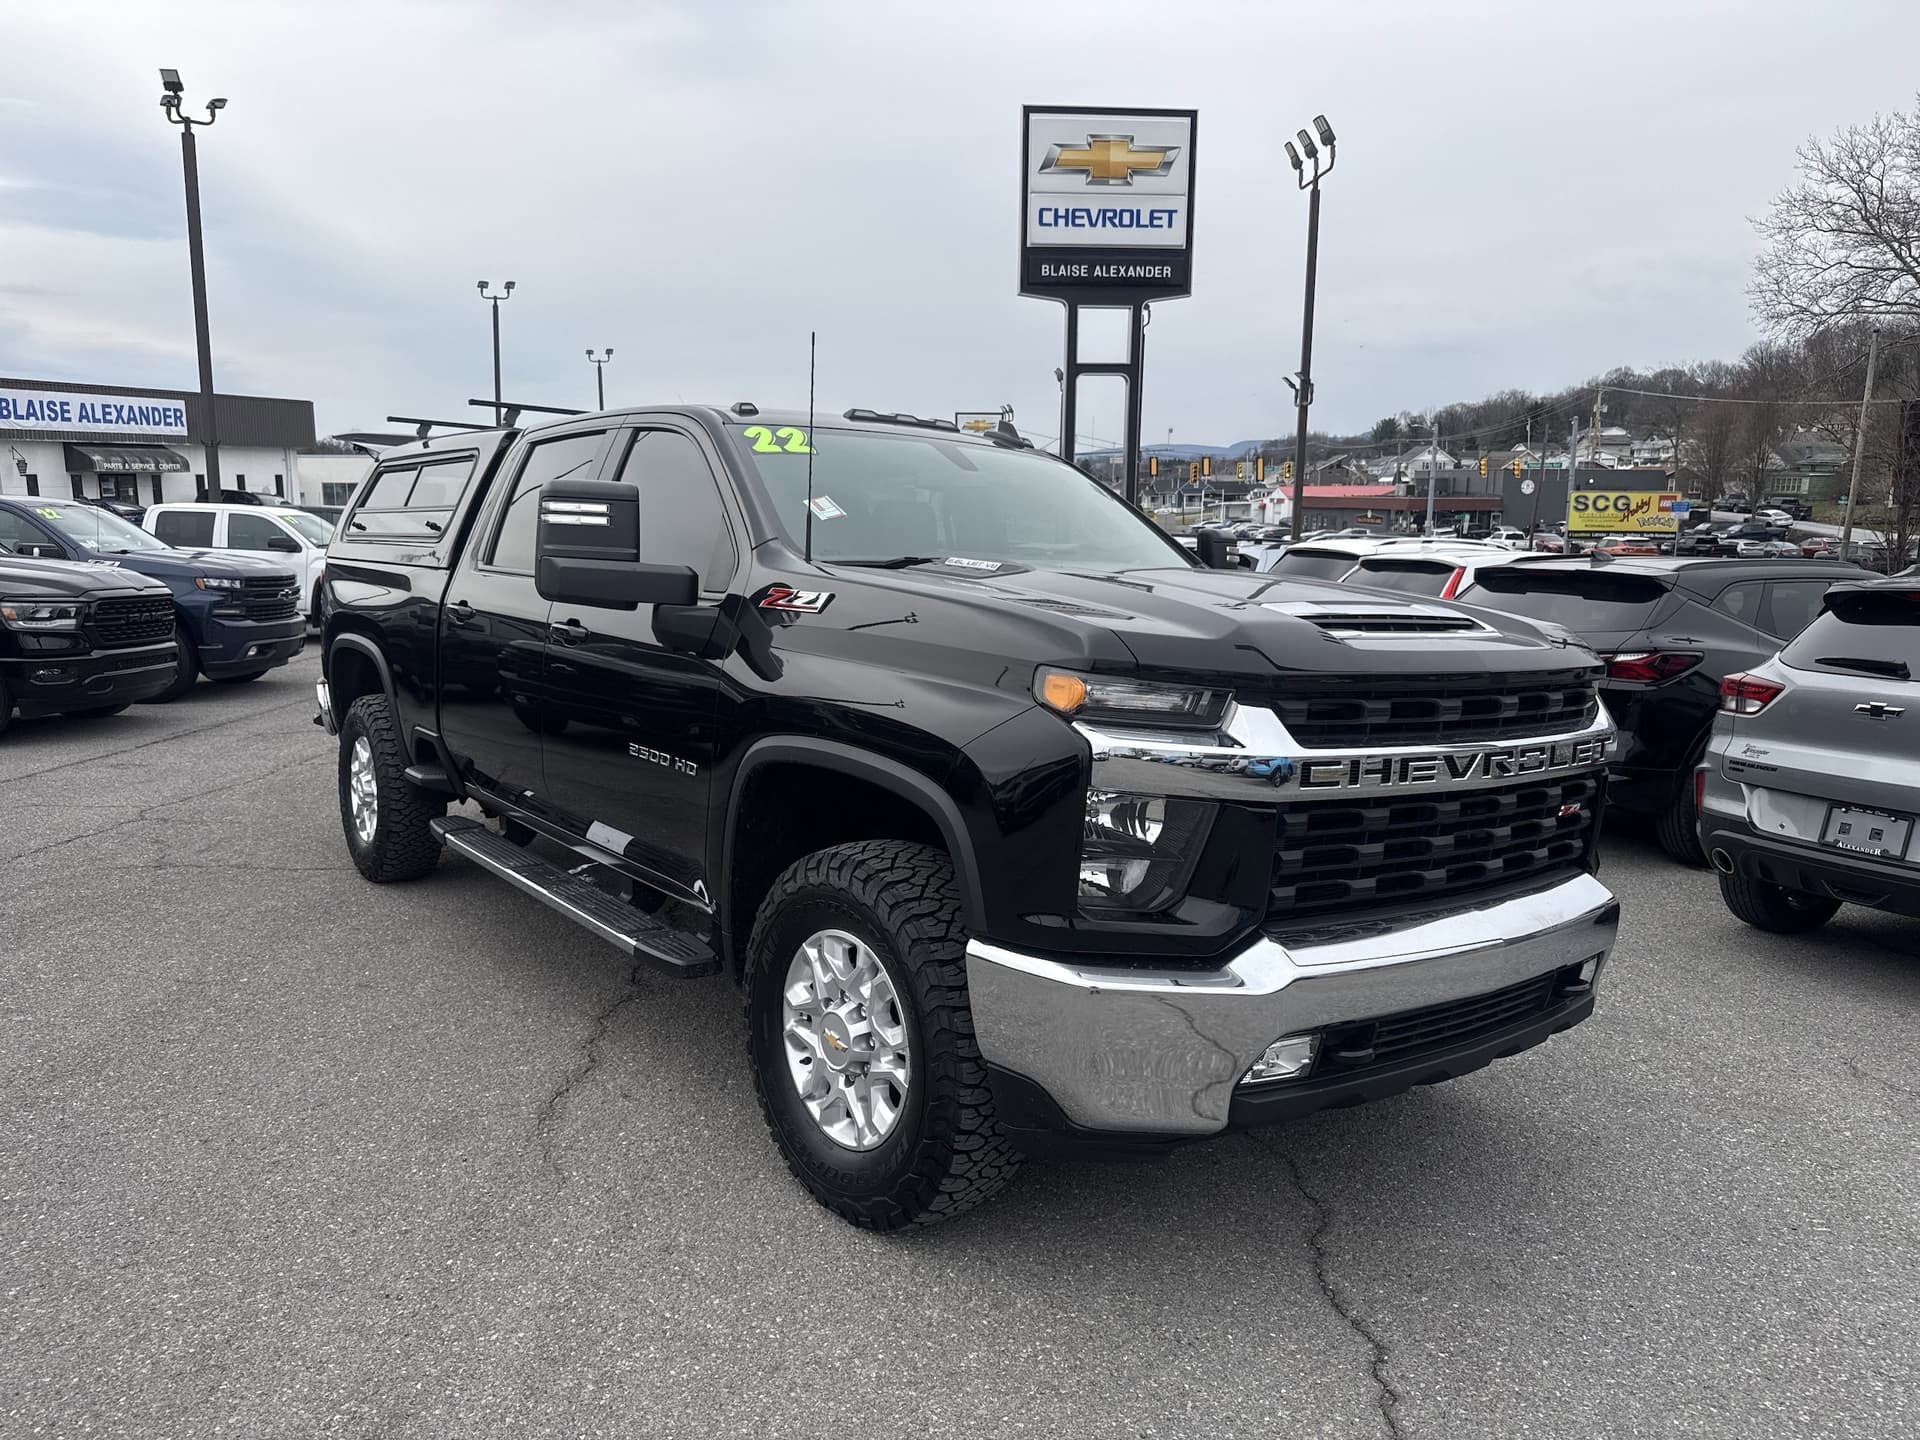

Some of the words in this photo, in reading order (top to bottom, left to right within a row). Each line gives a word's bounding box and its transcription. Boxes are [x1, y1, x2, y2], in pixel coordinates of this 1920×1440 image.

[1038, 207, 1178, 229] CHEVROLET
[1041, 264, 1089, 277] BLAISE
[1093, 265, 1172, 278] ALEXANDER
[0, 397, 72, 422] BLAISE
[78, 402, 185, 427] ALEXANDER
[743, 426, 817, 454] 22
[103, 462, 124, 471] PARTS
[131, 463, 156, 471] SERVICE
[158, 463, 182, 471] CENTER
[1573, 495, 1631, 513] SCG
[759, 587, 836, 614] Z71
[628, 742, 670, 767] 2500
[674, 757, 698, 776] HD
[1300, 736, 1614, 790] CHEVROLET
[1836, 841, 1881, 856] ALEXANDER
